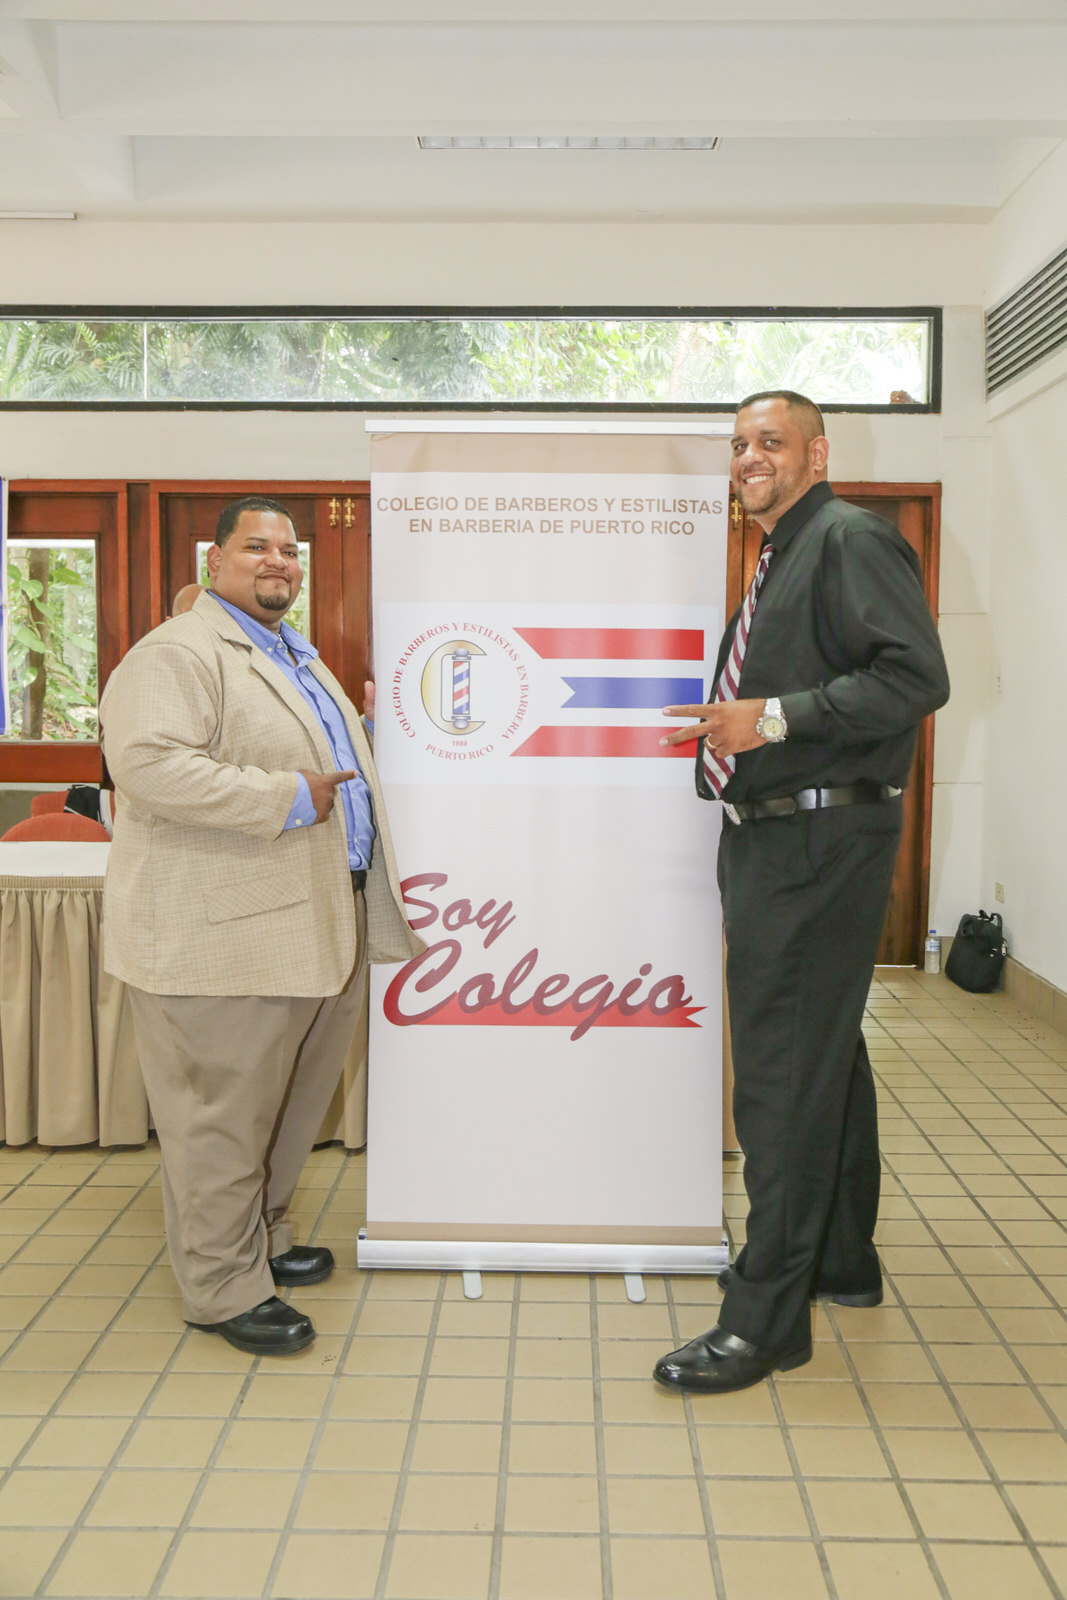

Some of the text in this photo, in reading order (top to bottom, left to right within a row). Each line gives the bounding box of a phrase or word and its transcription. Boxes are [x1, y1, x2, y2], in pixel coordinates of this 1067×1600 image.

[377, 497, 723, 514] COLEGIO DE BARBEROS Y ESTILISTAS
[409, 519, 695, 536] EN BARBERIA DE PUERTO RICO
[392, 622, 529, 740] COLEGIO DE BARBEROS Y ESTILISTAS EN BARBERIA
[425, 744, 494, 760] PUERTO RICO
[400, 872, 516, 949] Soy
[383, 939, 693, 1041] Colegio
